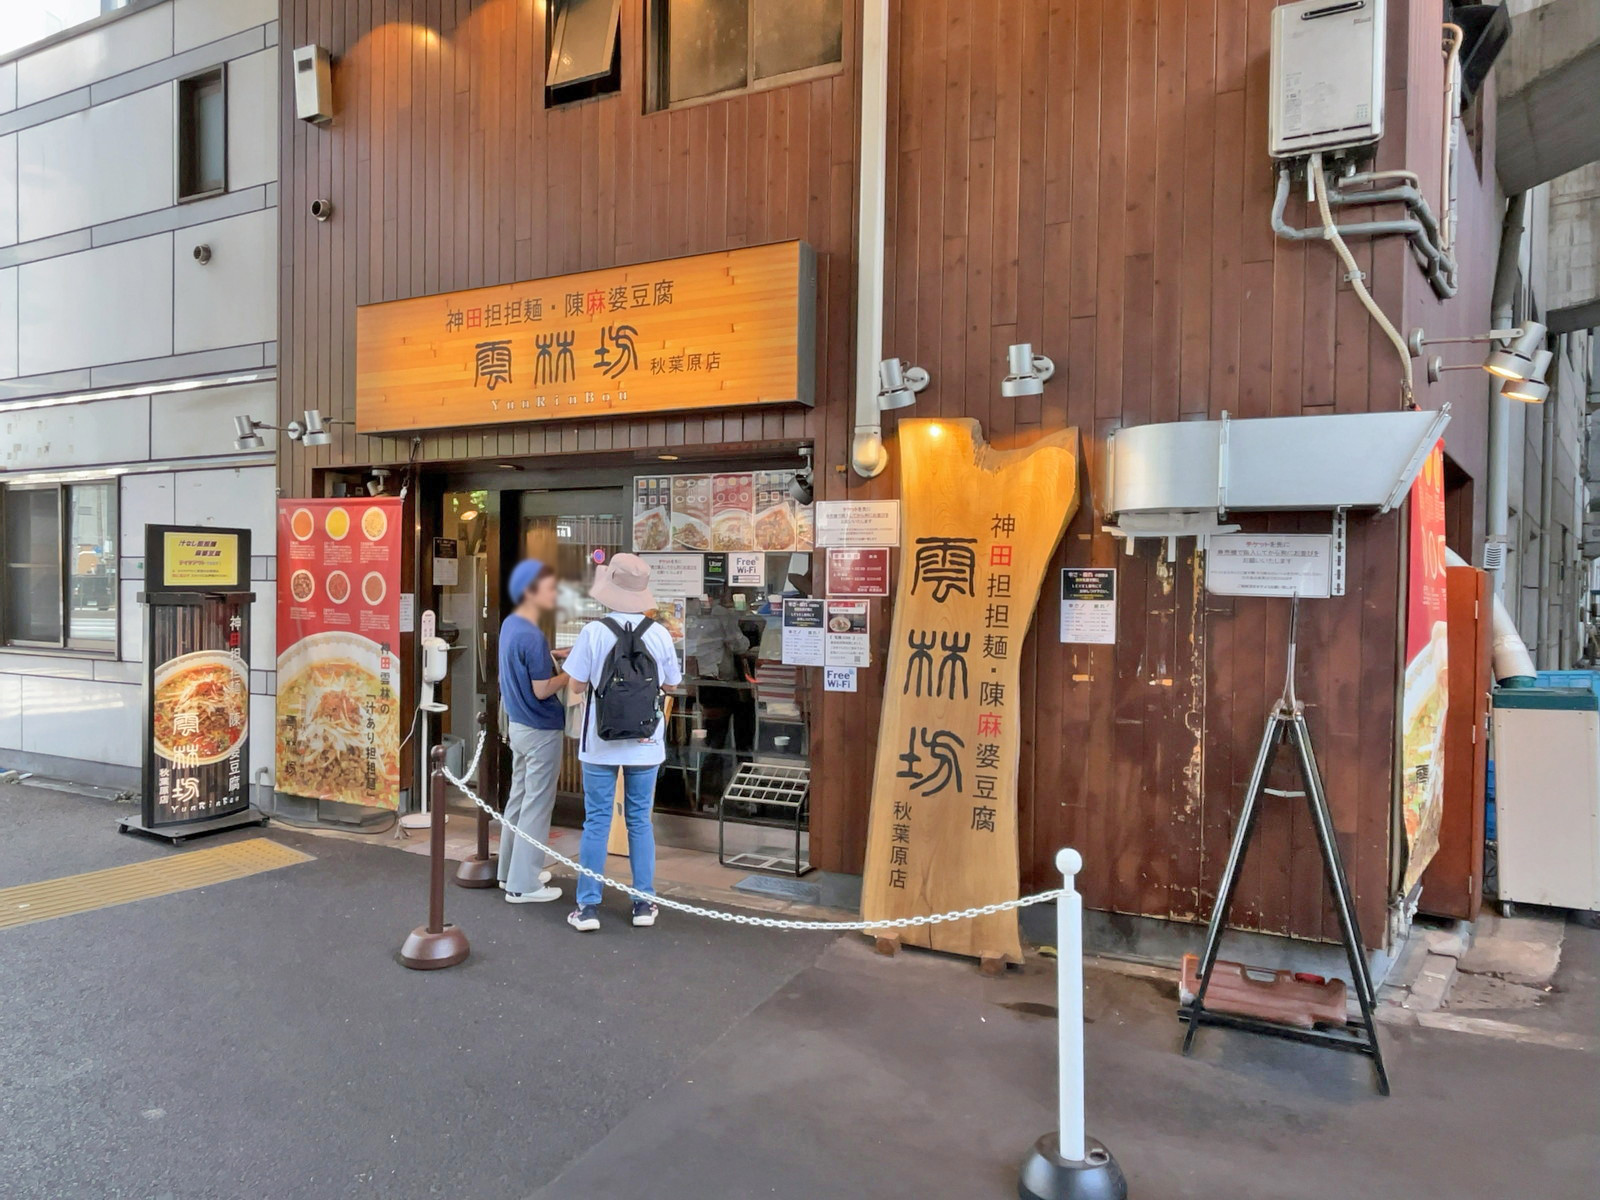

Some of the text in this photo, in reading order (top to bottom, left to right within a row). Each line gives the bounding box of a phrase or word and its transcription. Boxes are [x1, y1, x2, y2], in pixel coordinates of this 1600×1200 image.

[446, 279, 674, 333] 神田担担麺・陳麻婆豆腐
[474, 325, 639, 390] 雲林坊
[650, 351, 721, 376] 秋葉原店
[736, 558, 756, 566] Free
[736, 566, 756, 574] Wi-Fi
[826, 670, 850, 680] Free
[827, 679, 850, 689] Wi-Fi
[896, 537, 978, 798] 雲林坊
[970, 512, 1016, 834] 神田担担麺・陳麻婆豆腐
[171, 712, 200, 802] 雲林坊
[888, 801, 912, 890] 秋葉原店
